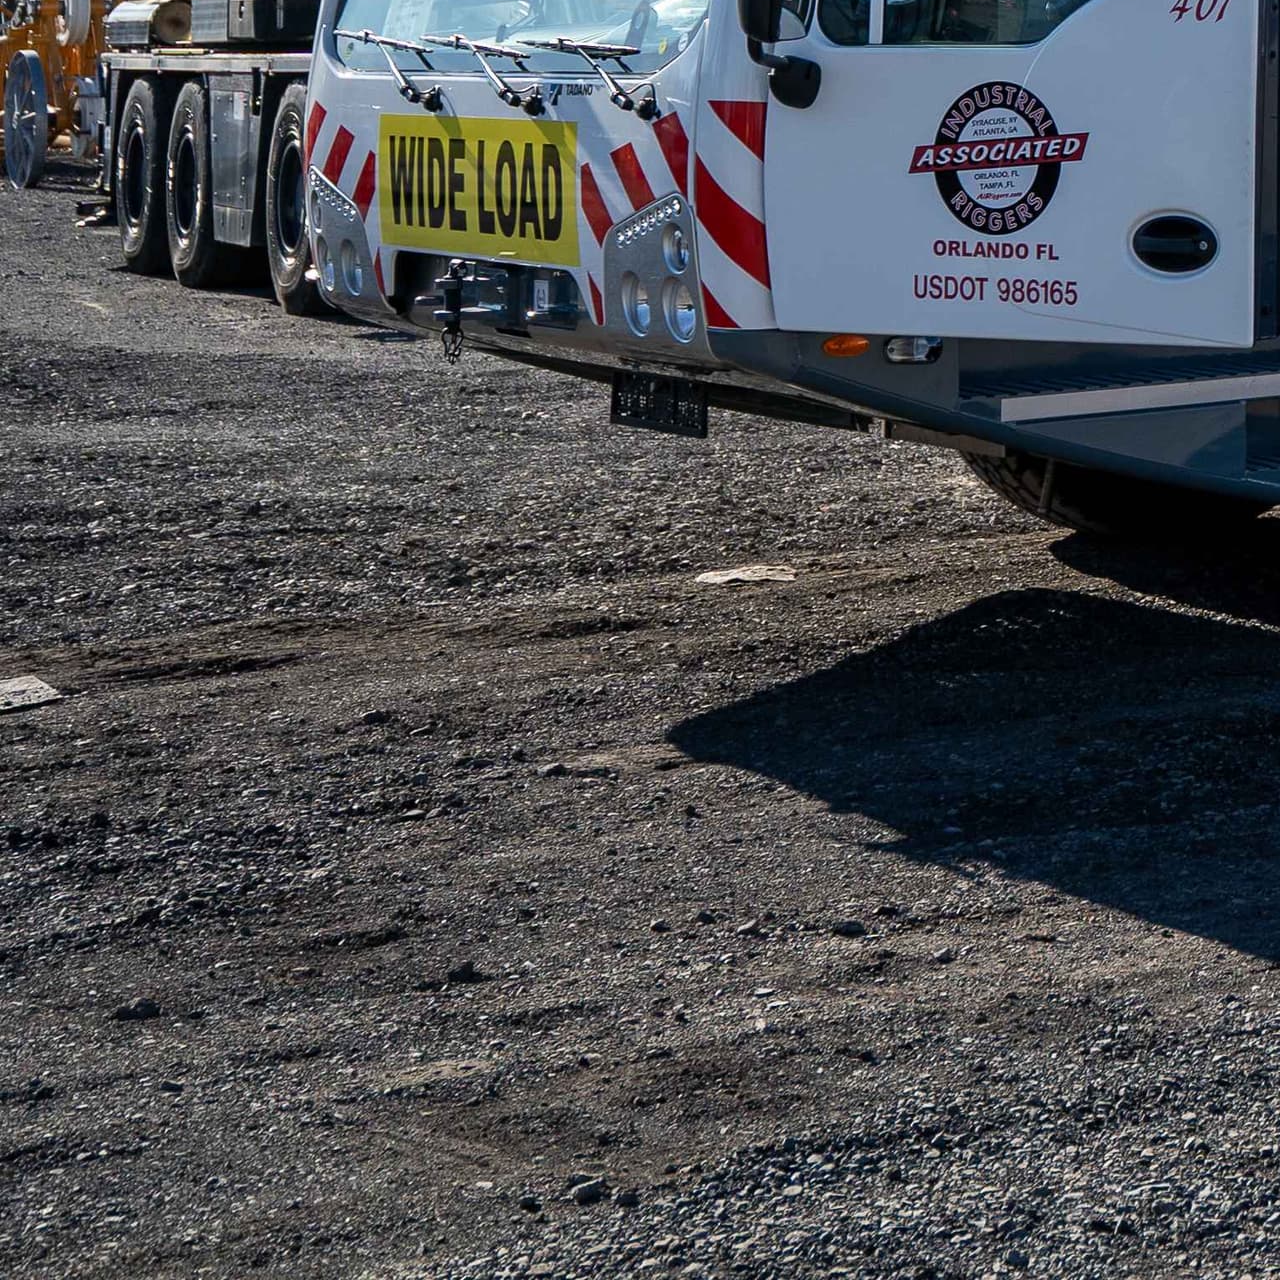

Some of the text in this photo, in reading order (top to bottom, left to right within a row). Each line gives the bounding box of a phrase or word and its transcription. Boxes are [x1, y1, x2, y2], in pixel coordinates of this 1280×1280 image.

[941, 85, 1053, 138] INDUSTRIAL
[973, 127, 1007, 136] ATLANTA,
[916, 138, 1081, 167] ASSOCIATED
[389, 135, 563, 241] WIDE LOAD
[980, 181, 1003, 190] TAMPA
[950, 190, 1044, 231] RIGGERS
[933, 240, 1059, 261] ORLANDO FL
[913, 275, 1078, 305] USDOT 986165
